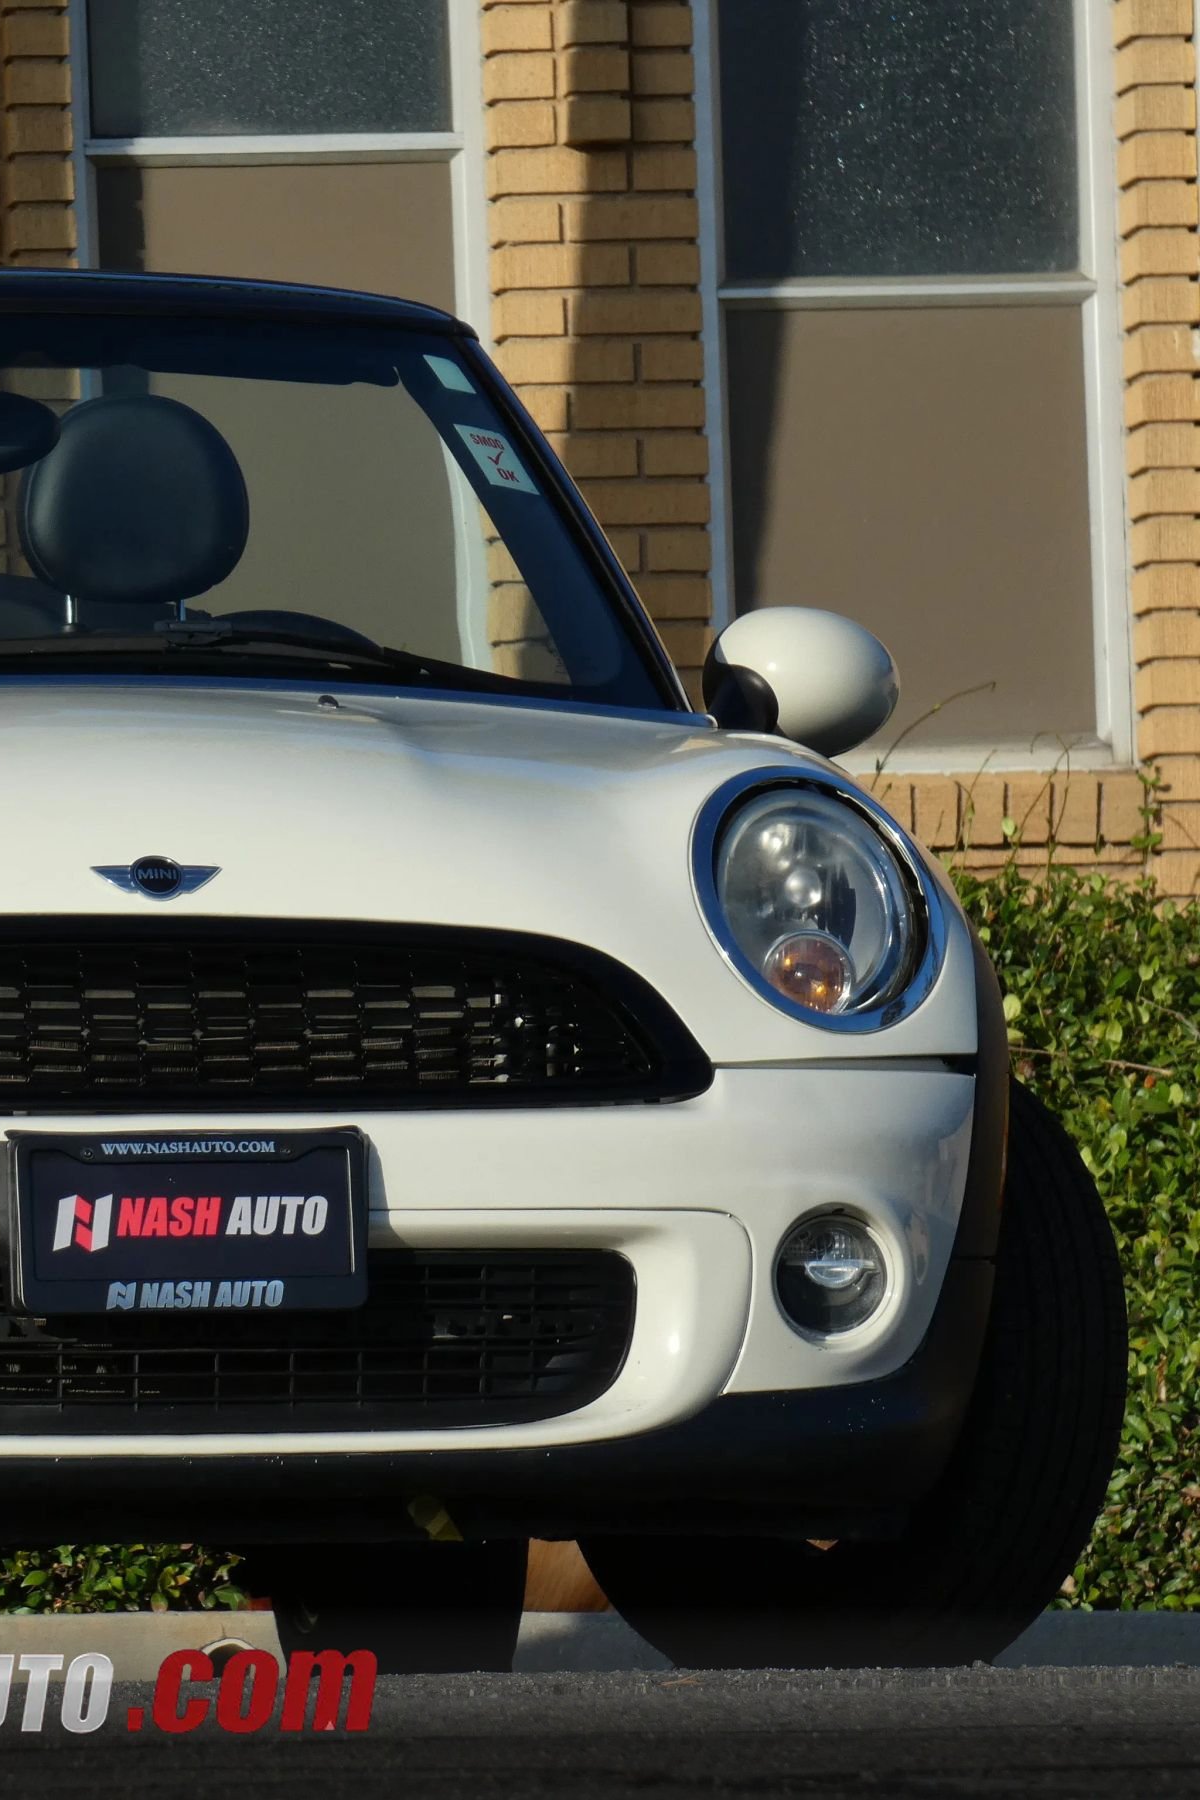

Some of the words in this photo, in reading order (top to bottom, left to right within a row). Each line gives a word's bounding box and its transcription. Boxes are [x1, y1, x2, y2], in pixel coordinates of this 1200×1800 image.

[469, 433, 505, 450] SMOG
[497, 467, 520, 483] OK
[137, 867, 178, 880] MINI
[100, 1140, 276, 1156] WWW.NASHAUTO.COM
[116, 1196, 223, 1238] NASH
[225, 1195, 329, 1236] AUTO
[139, 1280, 212, 1309] NASH
[214, 1279, 285, 1308] AUTO
